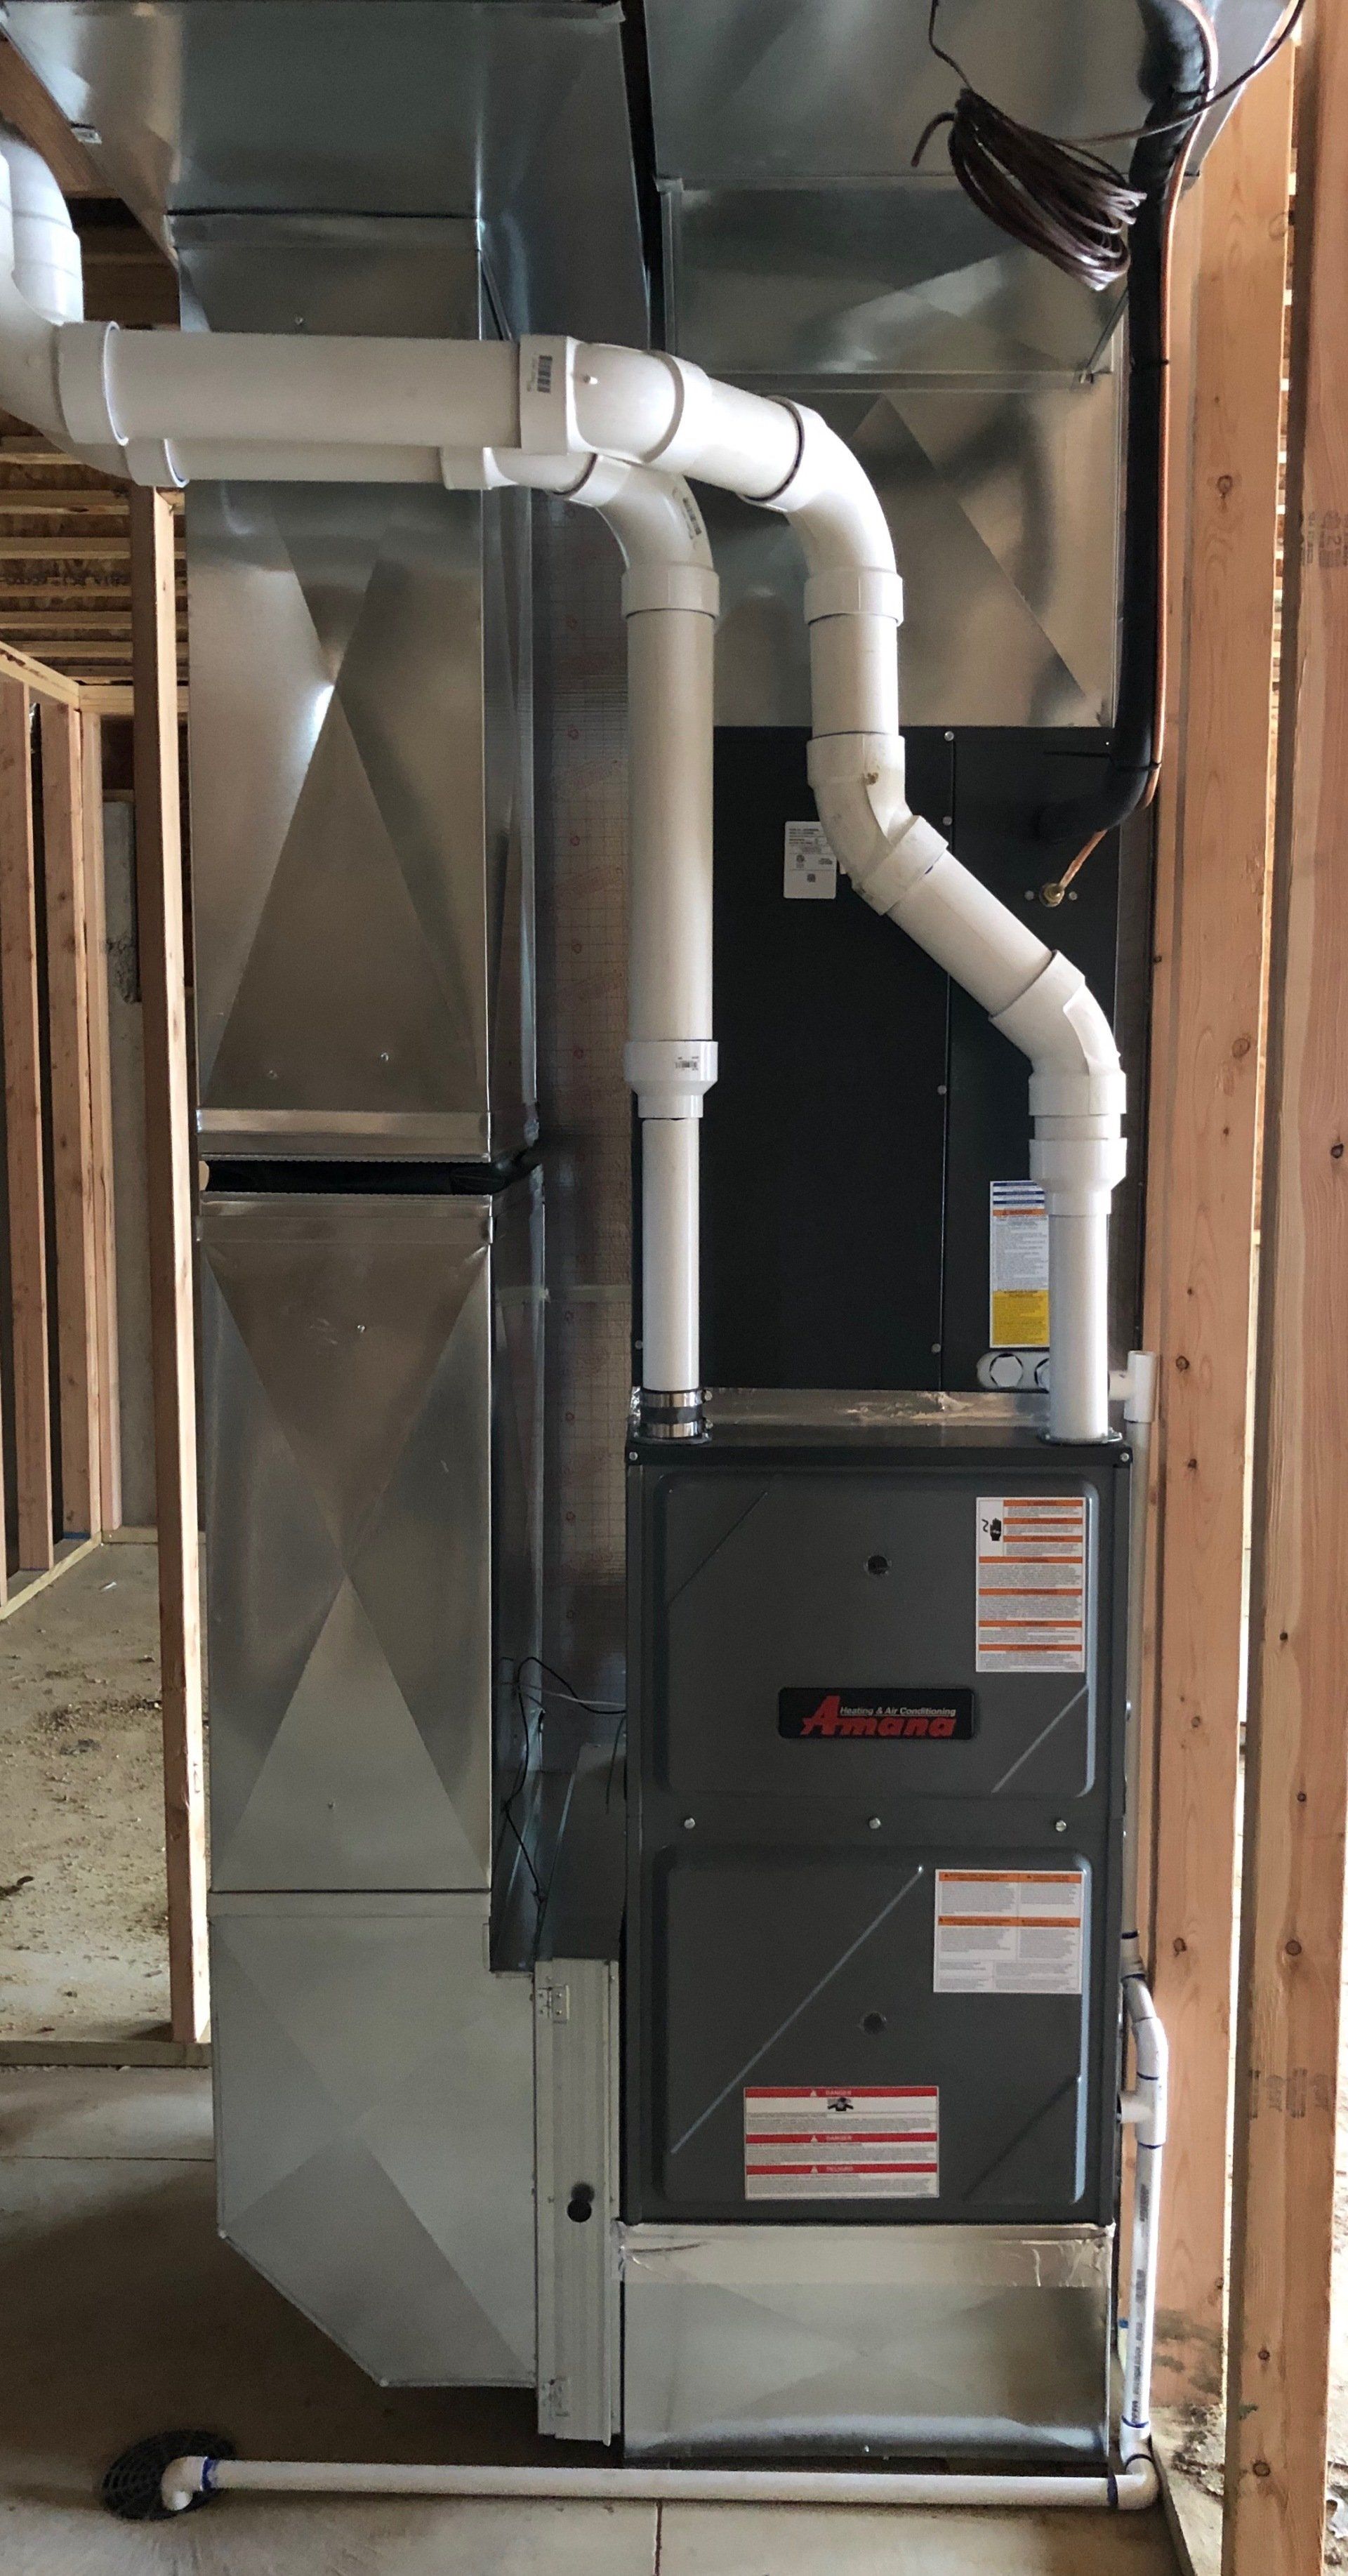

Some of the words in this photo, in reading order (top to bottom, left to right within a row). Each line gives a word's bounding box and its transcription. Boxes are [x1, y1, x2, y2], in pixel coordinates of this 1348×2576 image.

[800, 1695, 957, 1737] Amana
[840, 1707, 874, 1715] Heating
[899, 1707, 956, 1717] Conditioning
